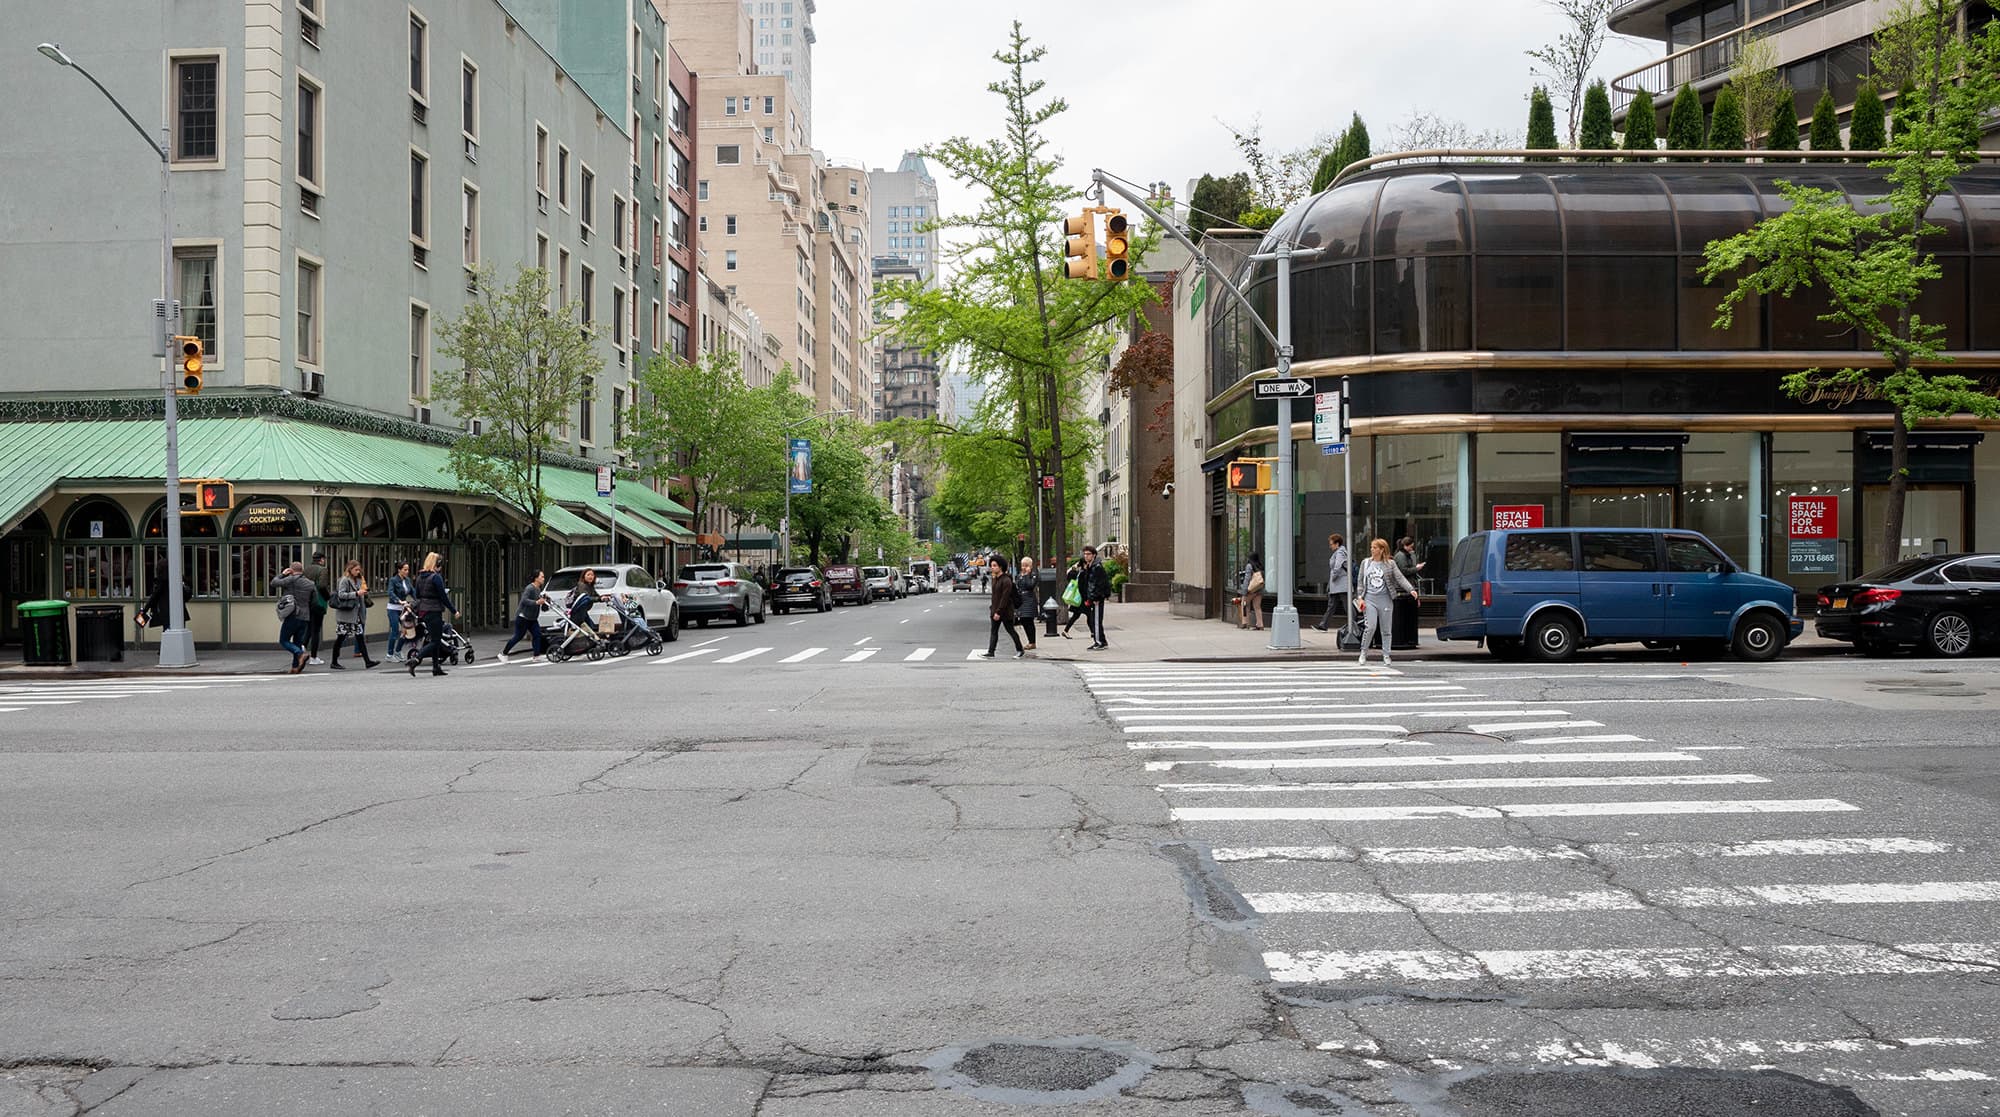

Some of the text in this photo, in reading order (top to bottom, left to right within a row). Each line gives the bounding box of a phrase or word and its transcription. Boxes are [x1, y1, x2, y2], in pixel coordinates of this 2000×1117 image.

[1263, 383, 1306, 392] ONE WAY
[1317, 415, 1322, 423] 2
[1791, 502, 1827, 510] RETAIL
[1496, 512, 1532, 520] RETAIL
[1791, 510, 1824, 518] SPACE
[1496, 520, 1529, 528] SPACE
[1791, 518, 1813, 526] FOR
[92, 523, 100, 532] A
[1791, 526, 1823, 534] LEASE
[1791, 554, 1835, 562] 212 713 6865
